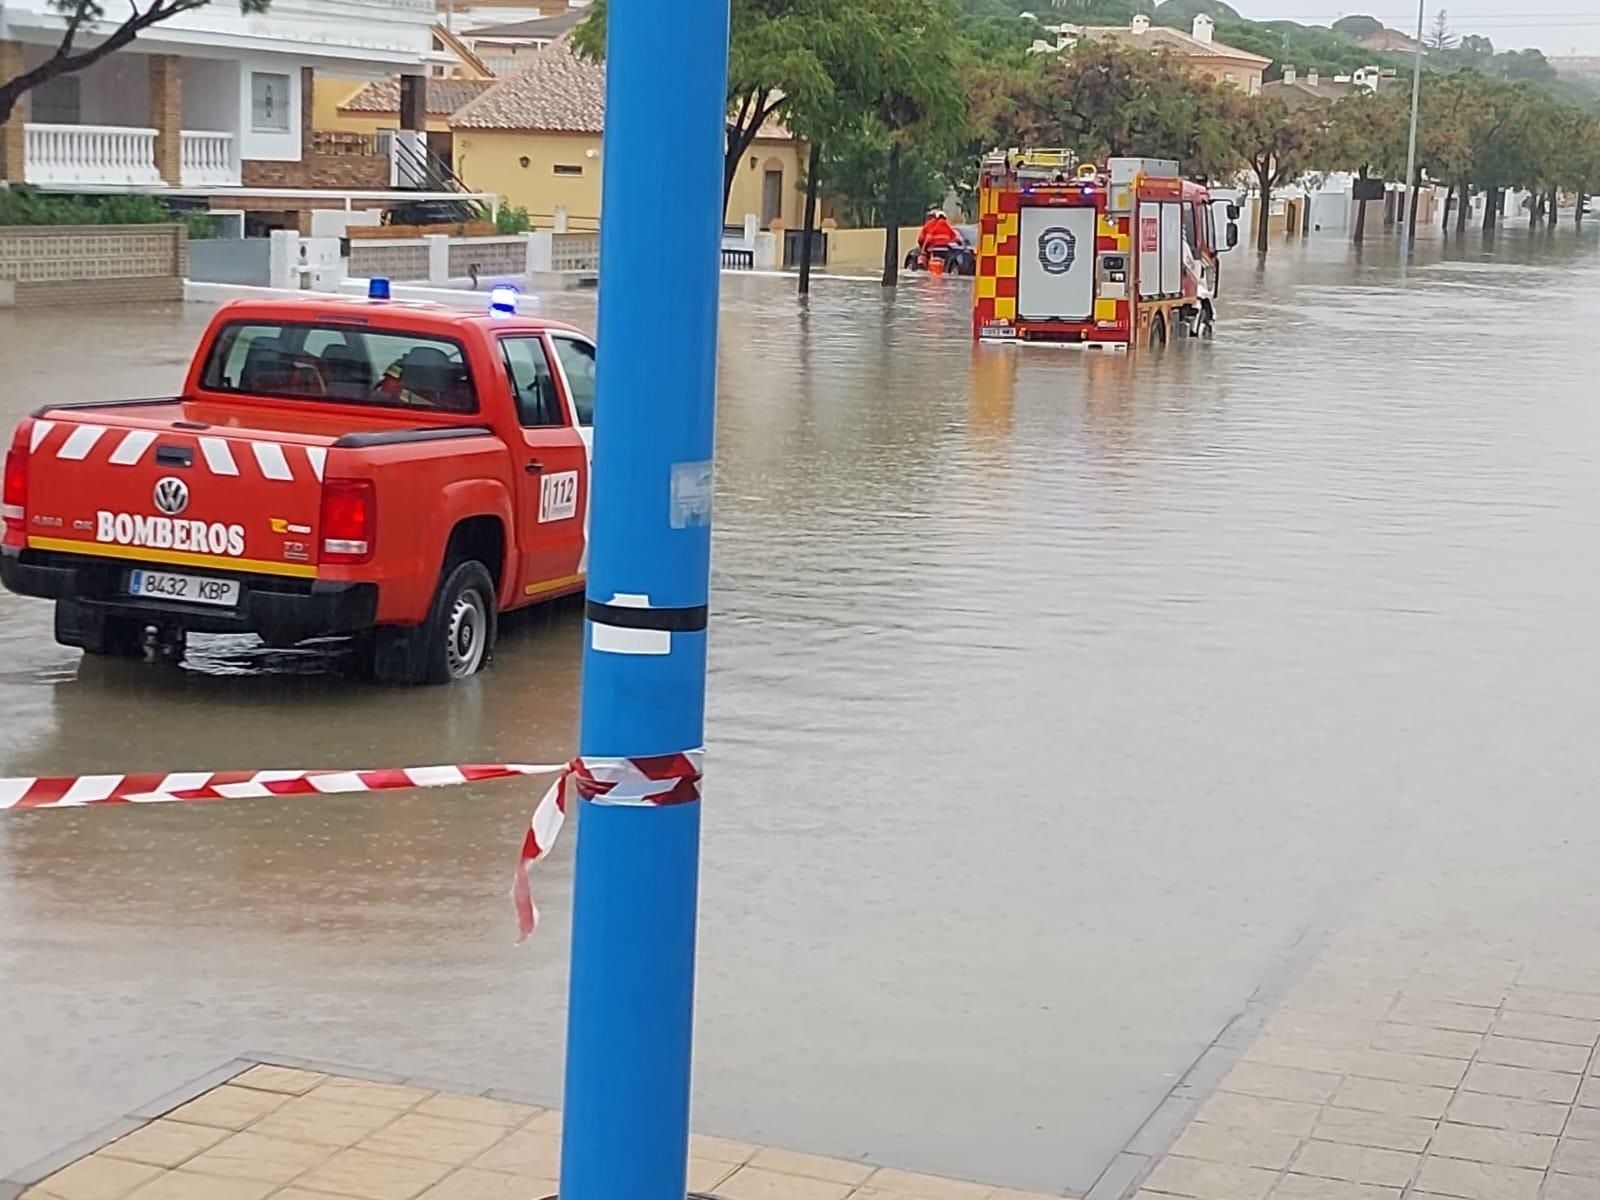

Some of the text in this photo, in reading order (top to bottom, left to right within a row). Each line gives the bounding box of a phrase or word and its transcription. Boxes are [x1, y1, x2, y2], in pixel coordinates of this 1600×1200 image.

[552, 477, 575, 505] 112
[96, 510, 245, 556] BOMBEROS
[145, 575, 188, 597] 8432
[198, 580, 231, 601] KBP
